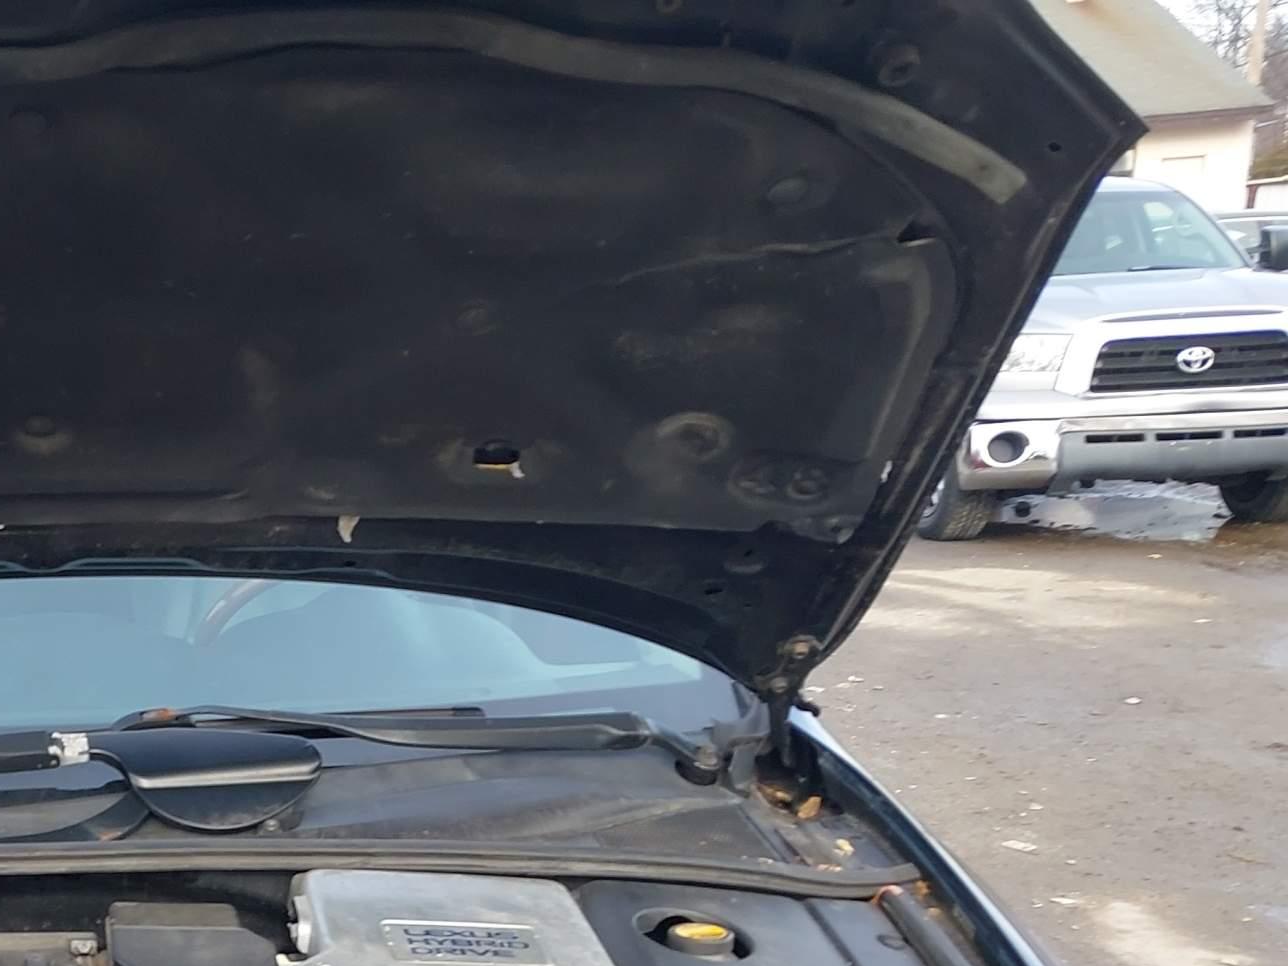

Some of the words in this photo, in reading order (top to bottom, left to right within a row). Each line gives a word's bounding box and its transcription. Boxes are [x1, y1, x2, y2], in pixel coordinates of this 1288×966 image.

[403, 928, 519, 940] LEXUS
[407, 937, 530, 949] HYBRID
[410, 947, 516, 958] DRIVE
